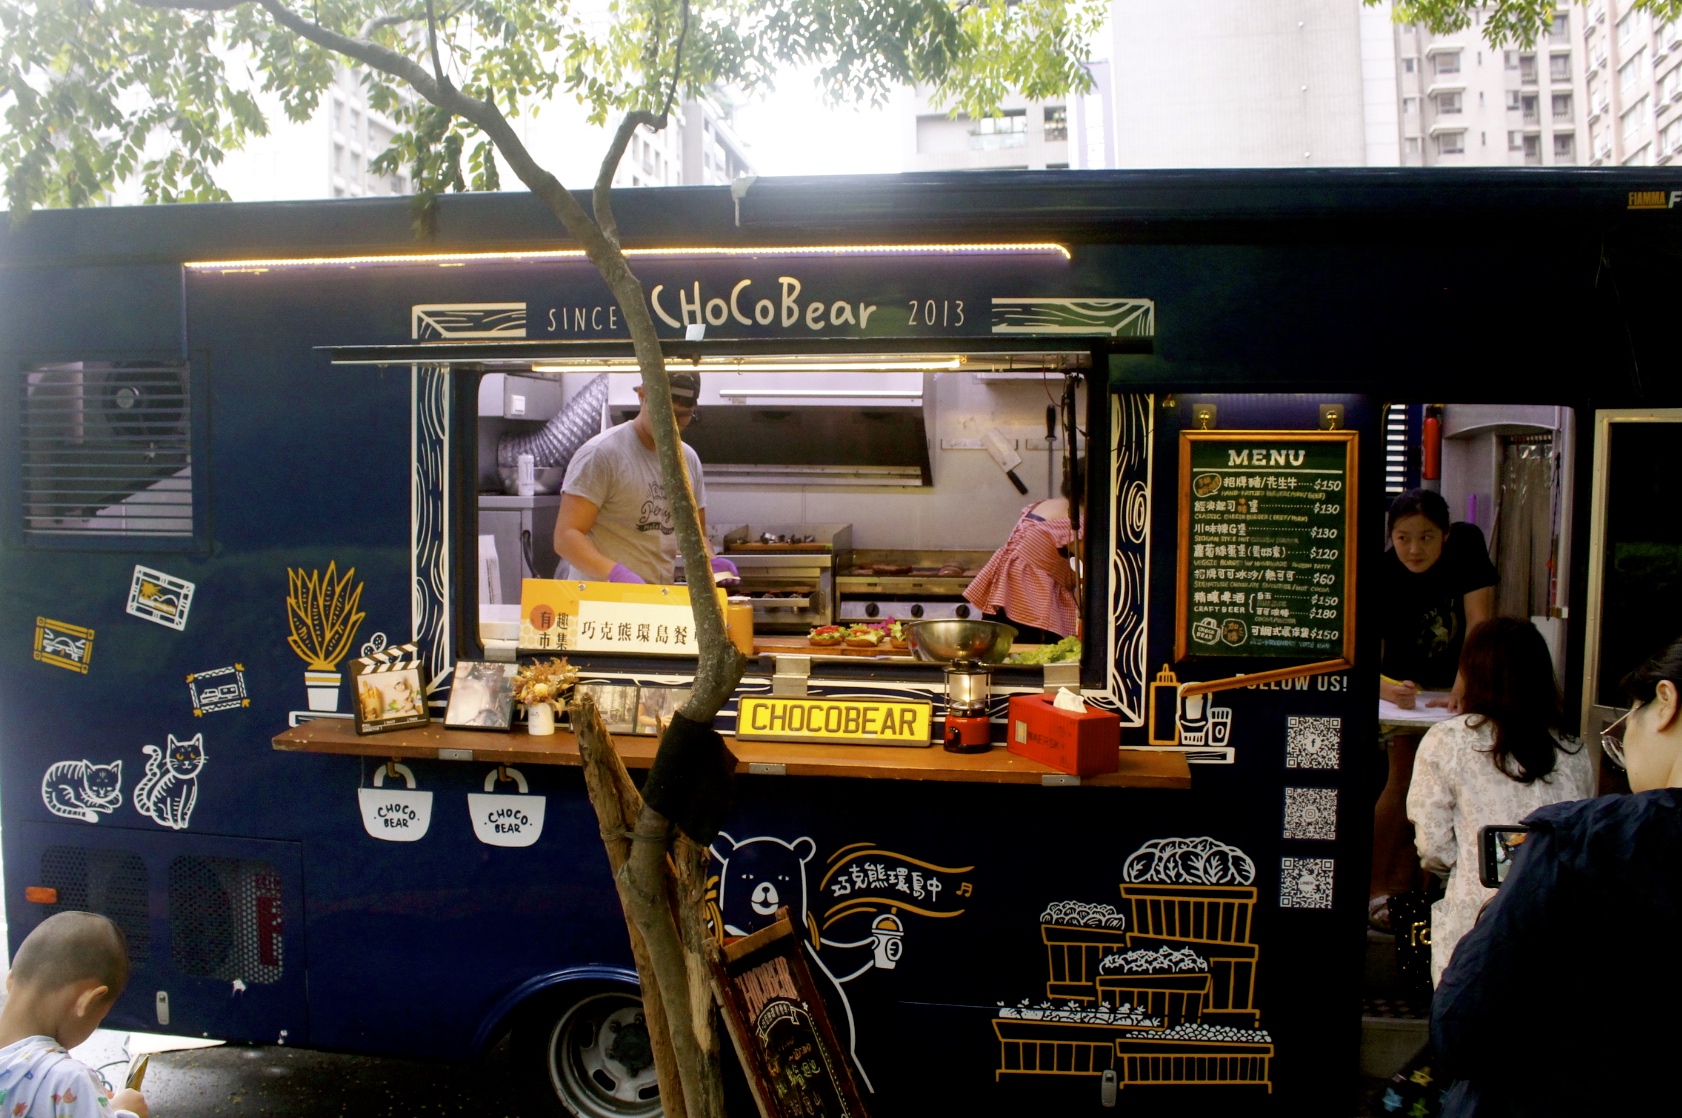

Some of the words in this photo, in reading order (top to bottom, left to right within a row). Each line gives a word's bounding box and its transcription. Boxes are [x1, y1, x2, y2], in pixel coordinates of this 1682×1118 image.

[1628, 191, 1666, 206] FIAMMA
[547, 307, 617, 332] SINCE
[908, 300, 965, 327] 2013
[1228, 449, 1305, 466] MENU
[1313, 478, 1341, 491] $150
[1313, 502, 1340, 514] $130
[1310, 526, 1337, 539] $130
[1310, 547, 1339, 560] $120
[1313, 572, 1335, 585] $60
[1311, 594, 1339, 606] $150
[1221, 606, 1246, 614] BEER
[1309, 607, 1337, 619] $180
[540, 611, 569, 630] 有趣
[1310, 627, 1339, 640] $150
[539, 632, 568, 650] 市集
[1317, 676, 1347, 692] US!
[751, 702, 919, 738] CHOCOBEAR
[377, 803, 416, 821] CHOCO
[488, 808, 528, 825] CHOCO
[384, 818, 409, 828] BEAR
[495, 823, 521, 833] BEAR
[831, 862, 942, 902] 巧克熊環島中
